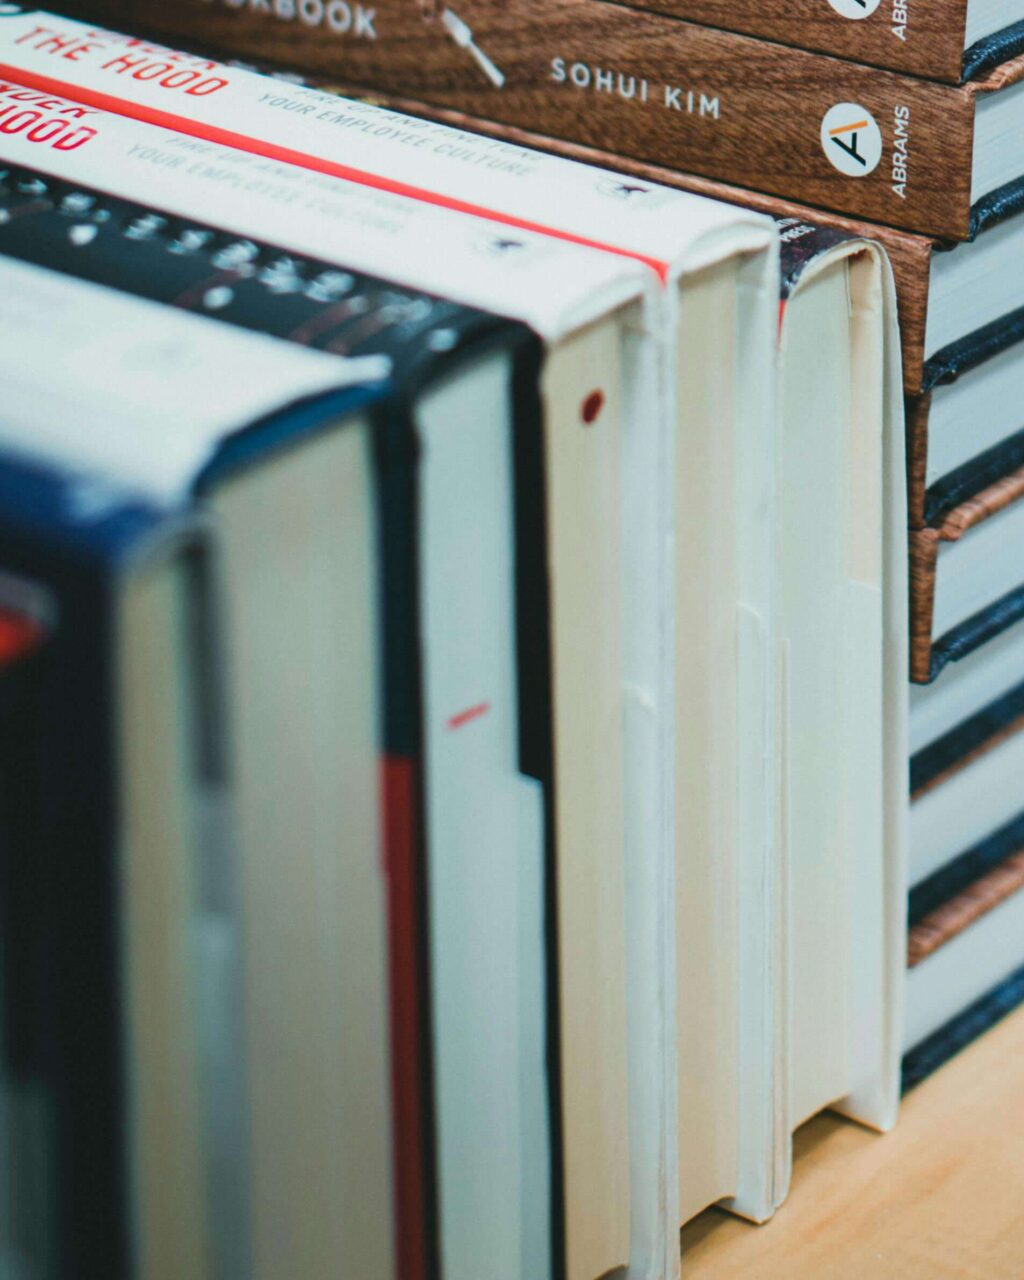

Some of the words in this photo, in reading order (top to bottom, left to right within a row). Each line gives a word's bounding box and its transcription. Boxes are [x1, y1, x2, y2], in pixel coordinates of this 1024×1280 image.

[15, 25, 104, 61] THE
[101, 53, 229, 96] HOOD
[551, 57, 648, 102] SOHUI
[665, 85, 721, 119] KIM
[258, 93, 316, 116] YOUR
[315, 110, 428, 148] EMPLOYEE
[433, 142, 538, 178] CULTURE
[892, 105, 909, 198] ABRAMS
